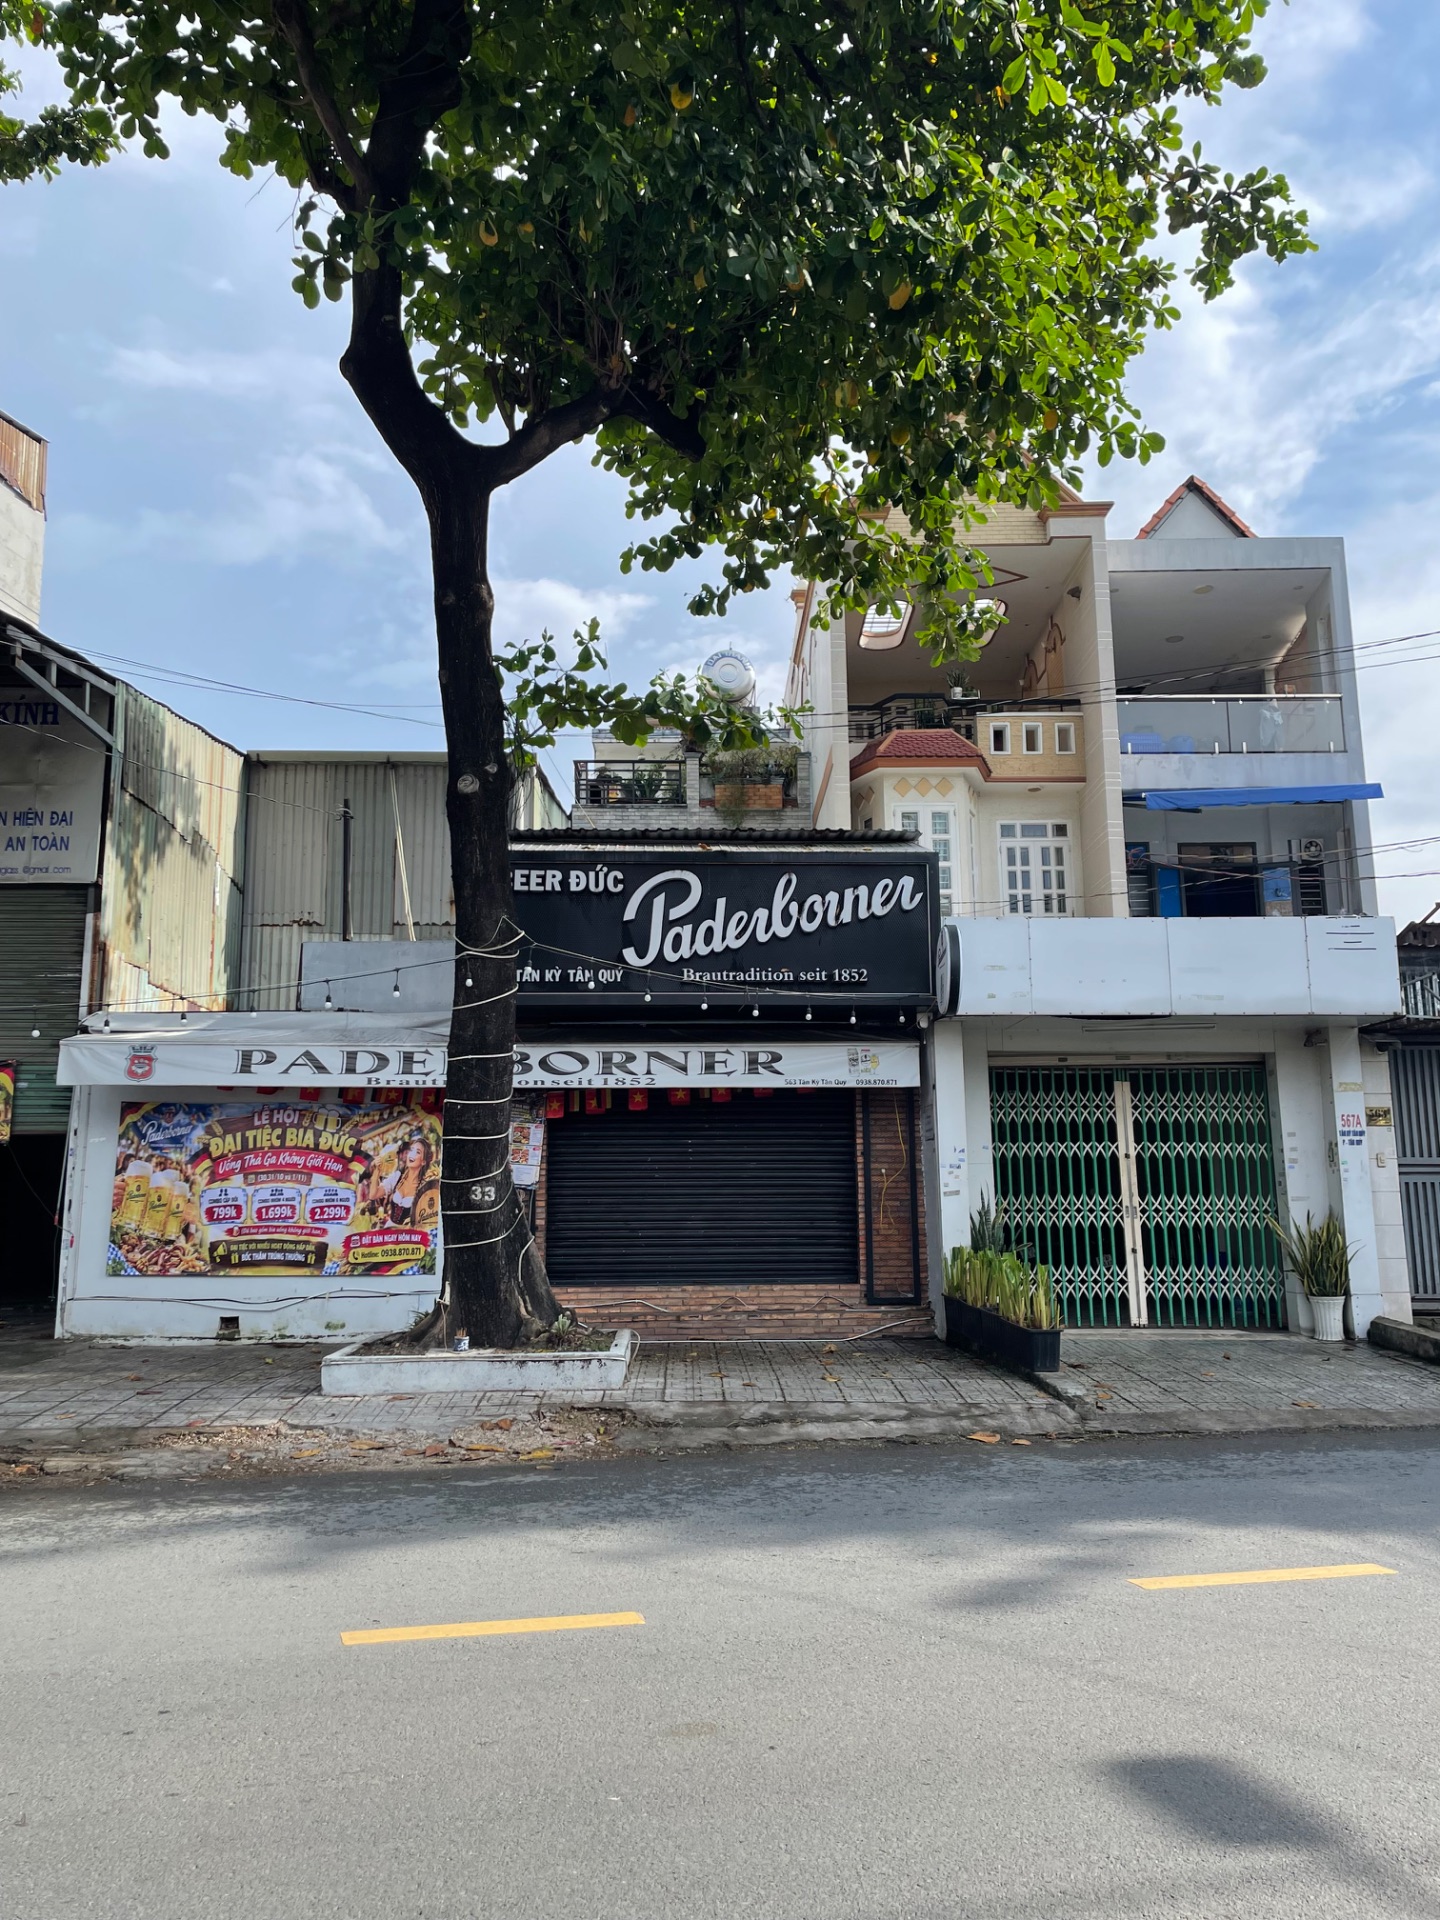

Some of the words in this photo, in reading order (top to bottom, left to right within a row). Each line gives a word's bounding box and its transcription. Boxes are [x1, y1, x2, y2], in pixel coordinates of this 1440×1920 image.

[13, 807, 44, 829] HIỆN
[49, 811, 73, 829] ĐẠI
[5, 836, 26, 851] AN
[32, 831, 70, 851] TOÀN
[510, 869, 562, 891] EER
[568, 864, 624, 893] ĐỨC
[622, 869, 923, 968] Paderborner
[545, 966, 562, 982] KỲ
[567, 966, 593, 982] TÂN
[598, 967, 623, 984] QUÝ
[682, 967, 794, 981] Brautradition
[799, 968, 828, 981] seit
[832, 968, 868, 982] 1852
[233, 1048, 785, 1078] PADEBORNER
[603, 1077, 657, 1086] 1852
[856, 1078, 899, 1086] 0938.870.871
[253, 1104, 271, 1126] LỄ
[272, 1106, 300, 1127] HỘI
[1341, 1114, 1363, 1128] 567A
[209, 1131, 242, 1157] ĐẠI
[245, 1124, 283, 1151] TIỆC
[285, 1127, 315, 1148] BIA
[244, 1152, 263, 1167] Thả
[264, 1152, 277, 1165] Ga
[277, 1152, 305, 1168] Không
[323, 1157, 344, 1173] Hạn
[471, 1186, 496, 1201] 33
[213, 1206, 237, 1219] 799k
[261, 1207, 293, 1219] 1.699k
[314, 1206, 347, 1219] 2.299k
[380, 1248, 421, 1257] 0938.870.871
